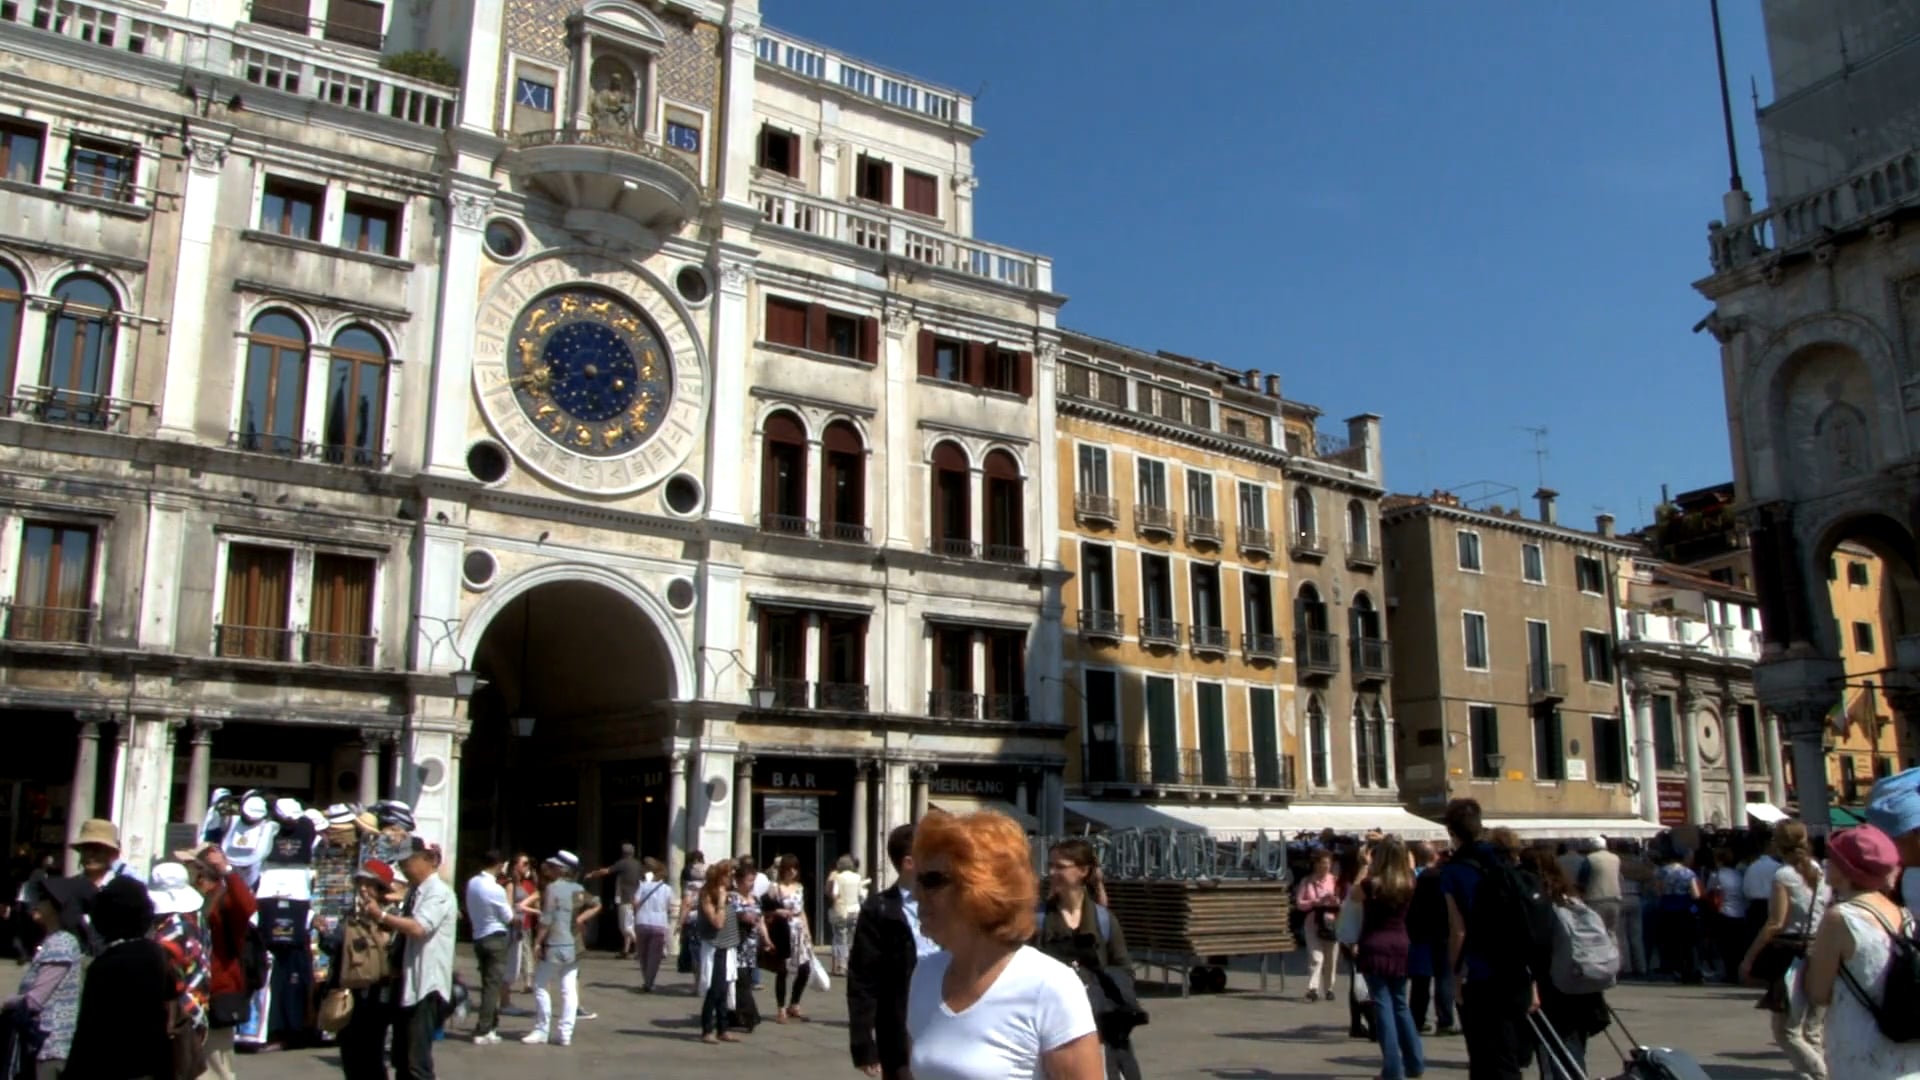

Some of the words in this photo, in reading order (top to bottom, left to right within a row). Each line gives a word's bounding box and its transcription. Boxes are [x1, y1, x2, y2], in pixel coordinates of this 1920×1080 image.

[519, 80, 549, 113] XI
[666, 125, 697, 152] 15
[771, 771, 817, 788] BAR
[928, 777, 1004, 796] MERICANO
